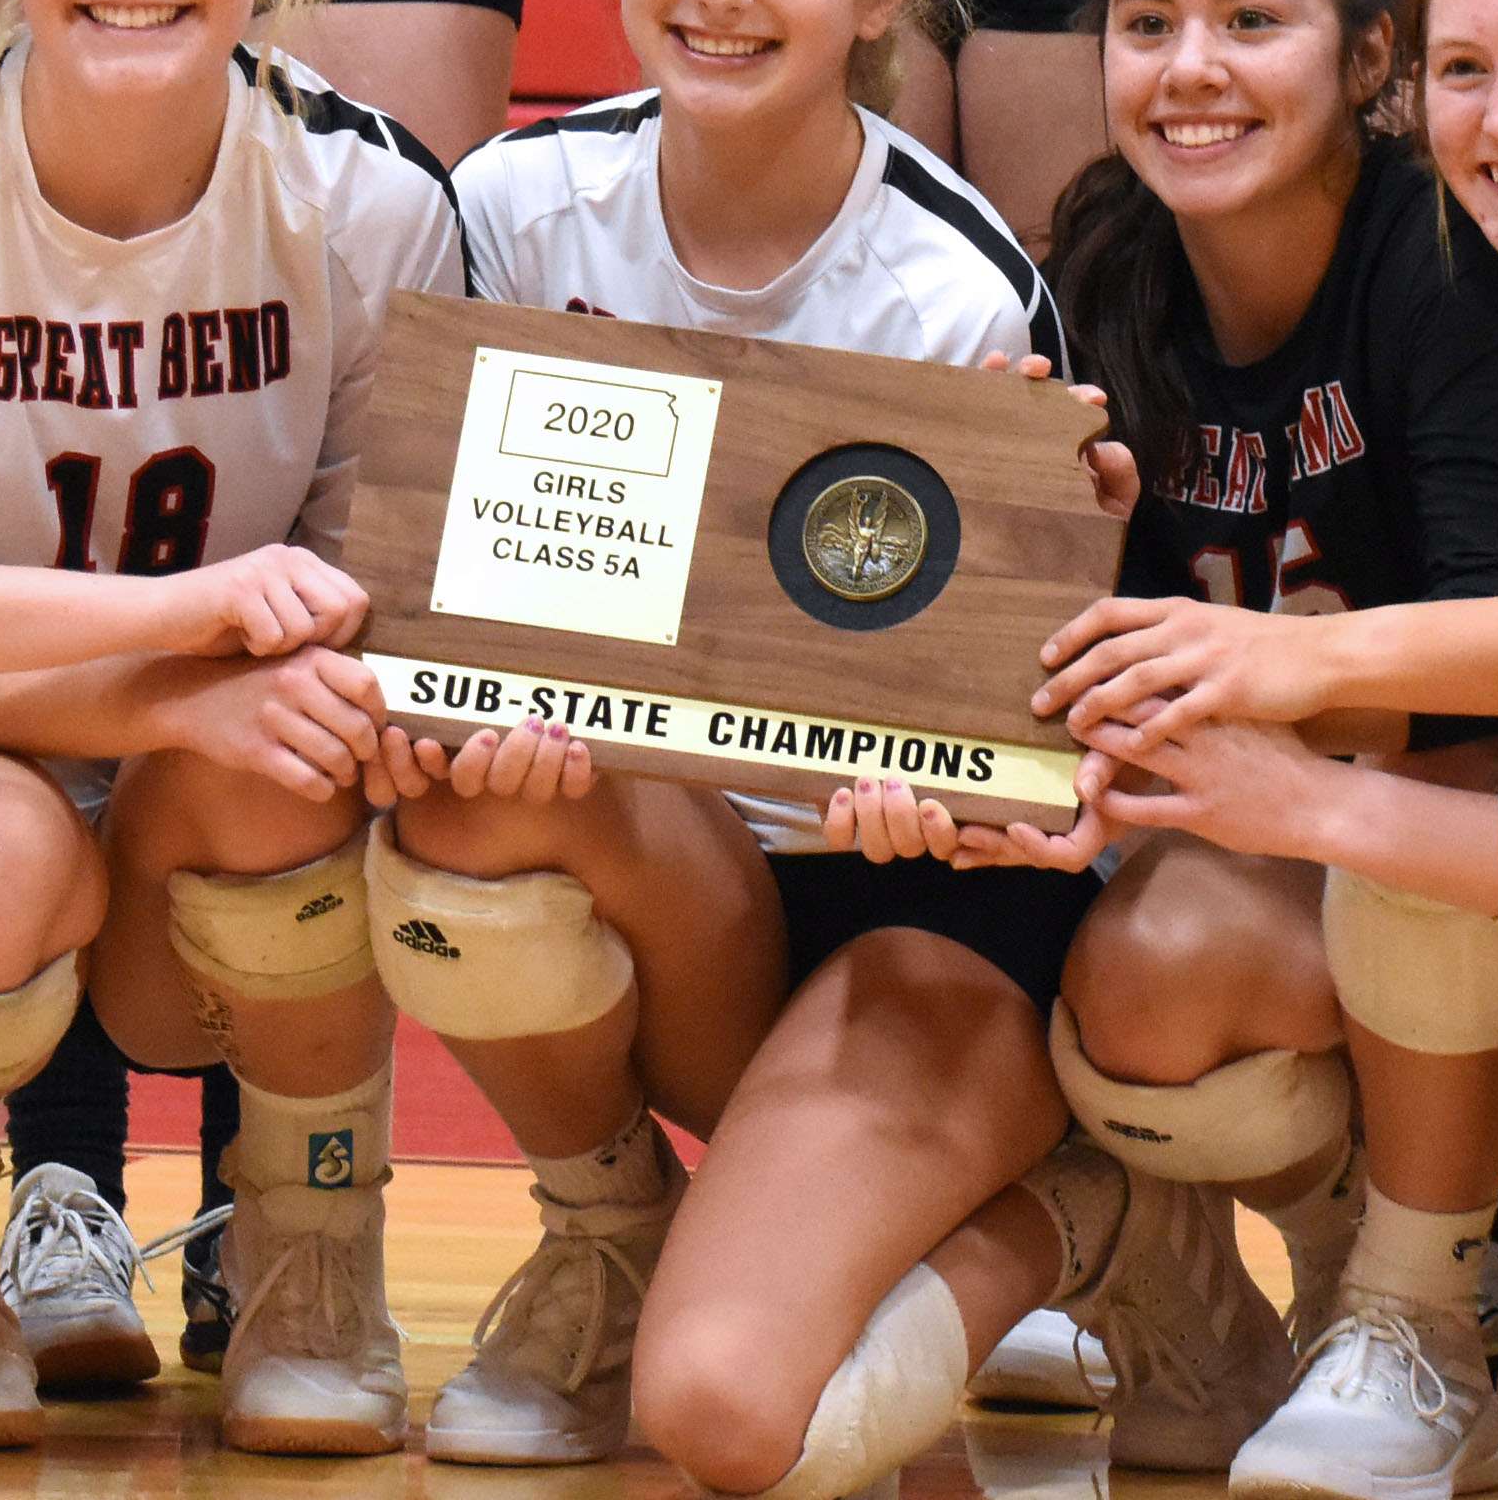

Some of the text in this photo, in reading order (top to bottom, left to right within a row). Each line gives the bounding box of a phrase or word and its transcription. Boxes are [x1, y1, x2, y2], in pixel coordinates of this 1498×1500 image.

[157, 299, 291, 401] BEND
[544, 402, 635, 442] 2020
[45, 444, 216, 577] 18
[533, 471, 627, 505] GIRLS
[472, 496, 675, 549] VOLLEYBALL
[492, 537, 641, 580] CLASS 5A
[410, 669, 997, 783] SUB-STATE CHAMPIONS
[392, 929, 461, 959] adidas
